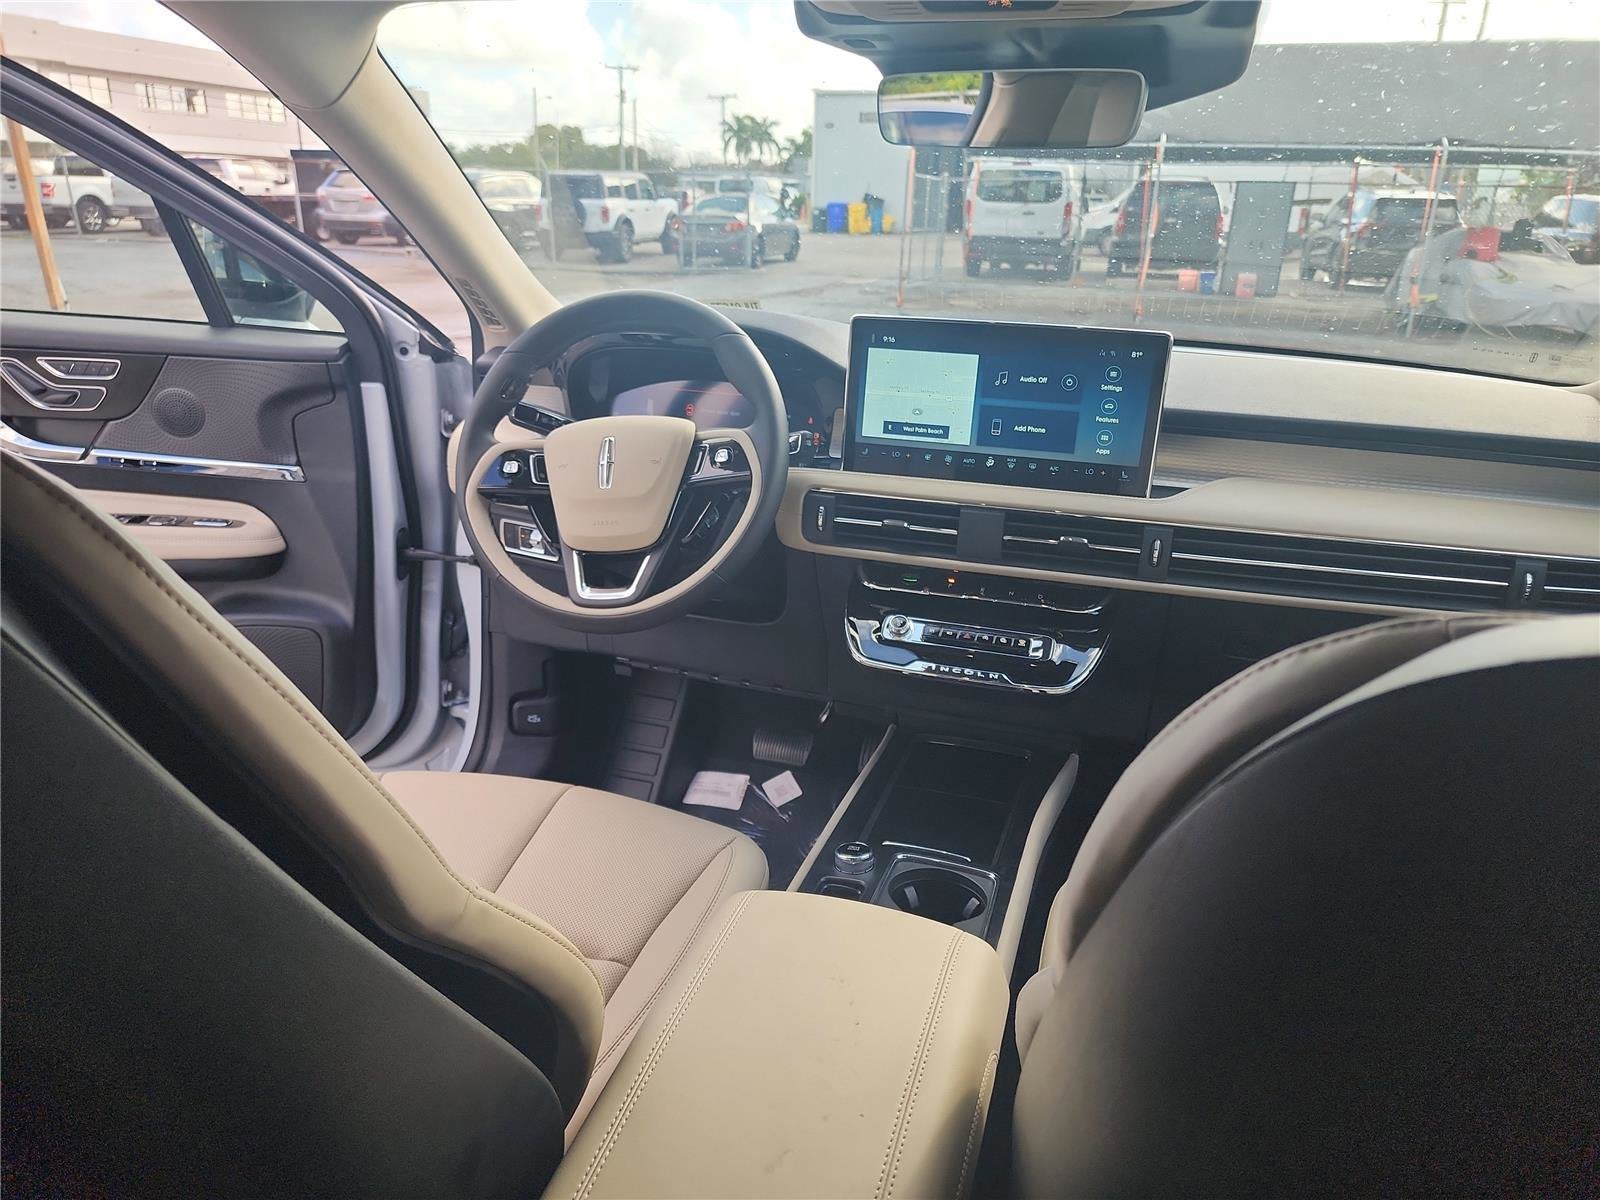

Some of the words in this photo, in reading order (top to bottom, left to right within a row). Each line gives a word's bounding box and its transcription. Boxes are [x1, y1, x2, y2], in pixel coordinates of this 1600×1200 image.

[1019, 375, 1037, 383] Audio
[1038, 376, 1048, 384] Off
[1100, 384, 1123, 393] Settings
[1095, 415, 1119, 424] Features
[928, 427, 944, 435] Beach
[1027, 425, 1046, 434] Phone
